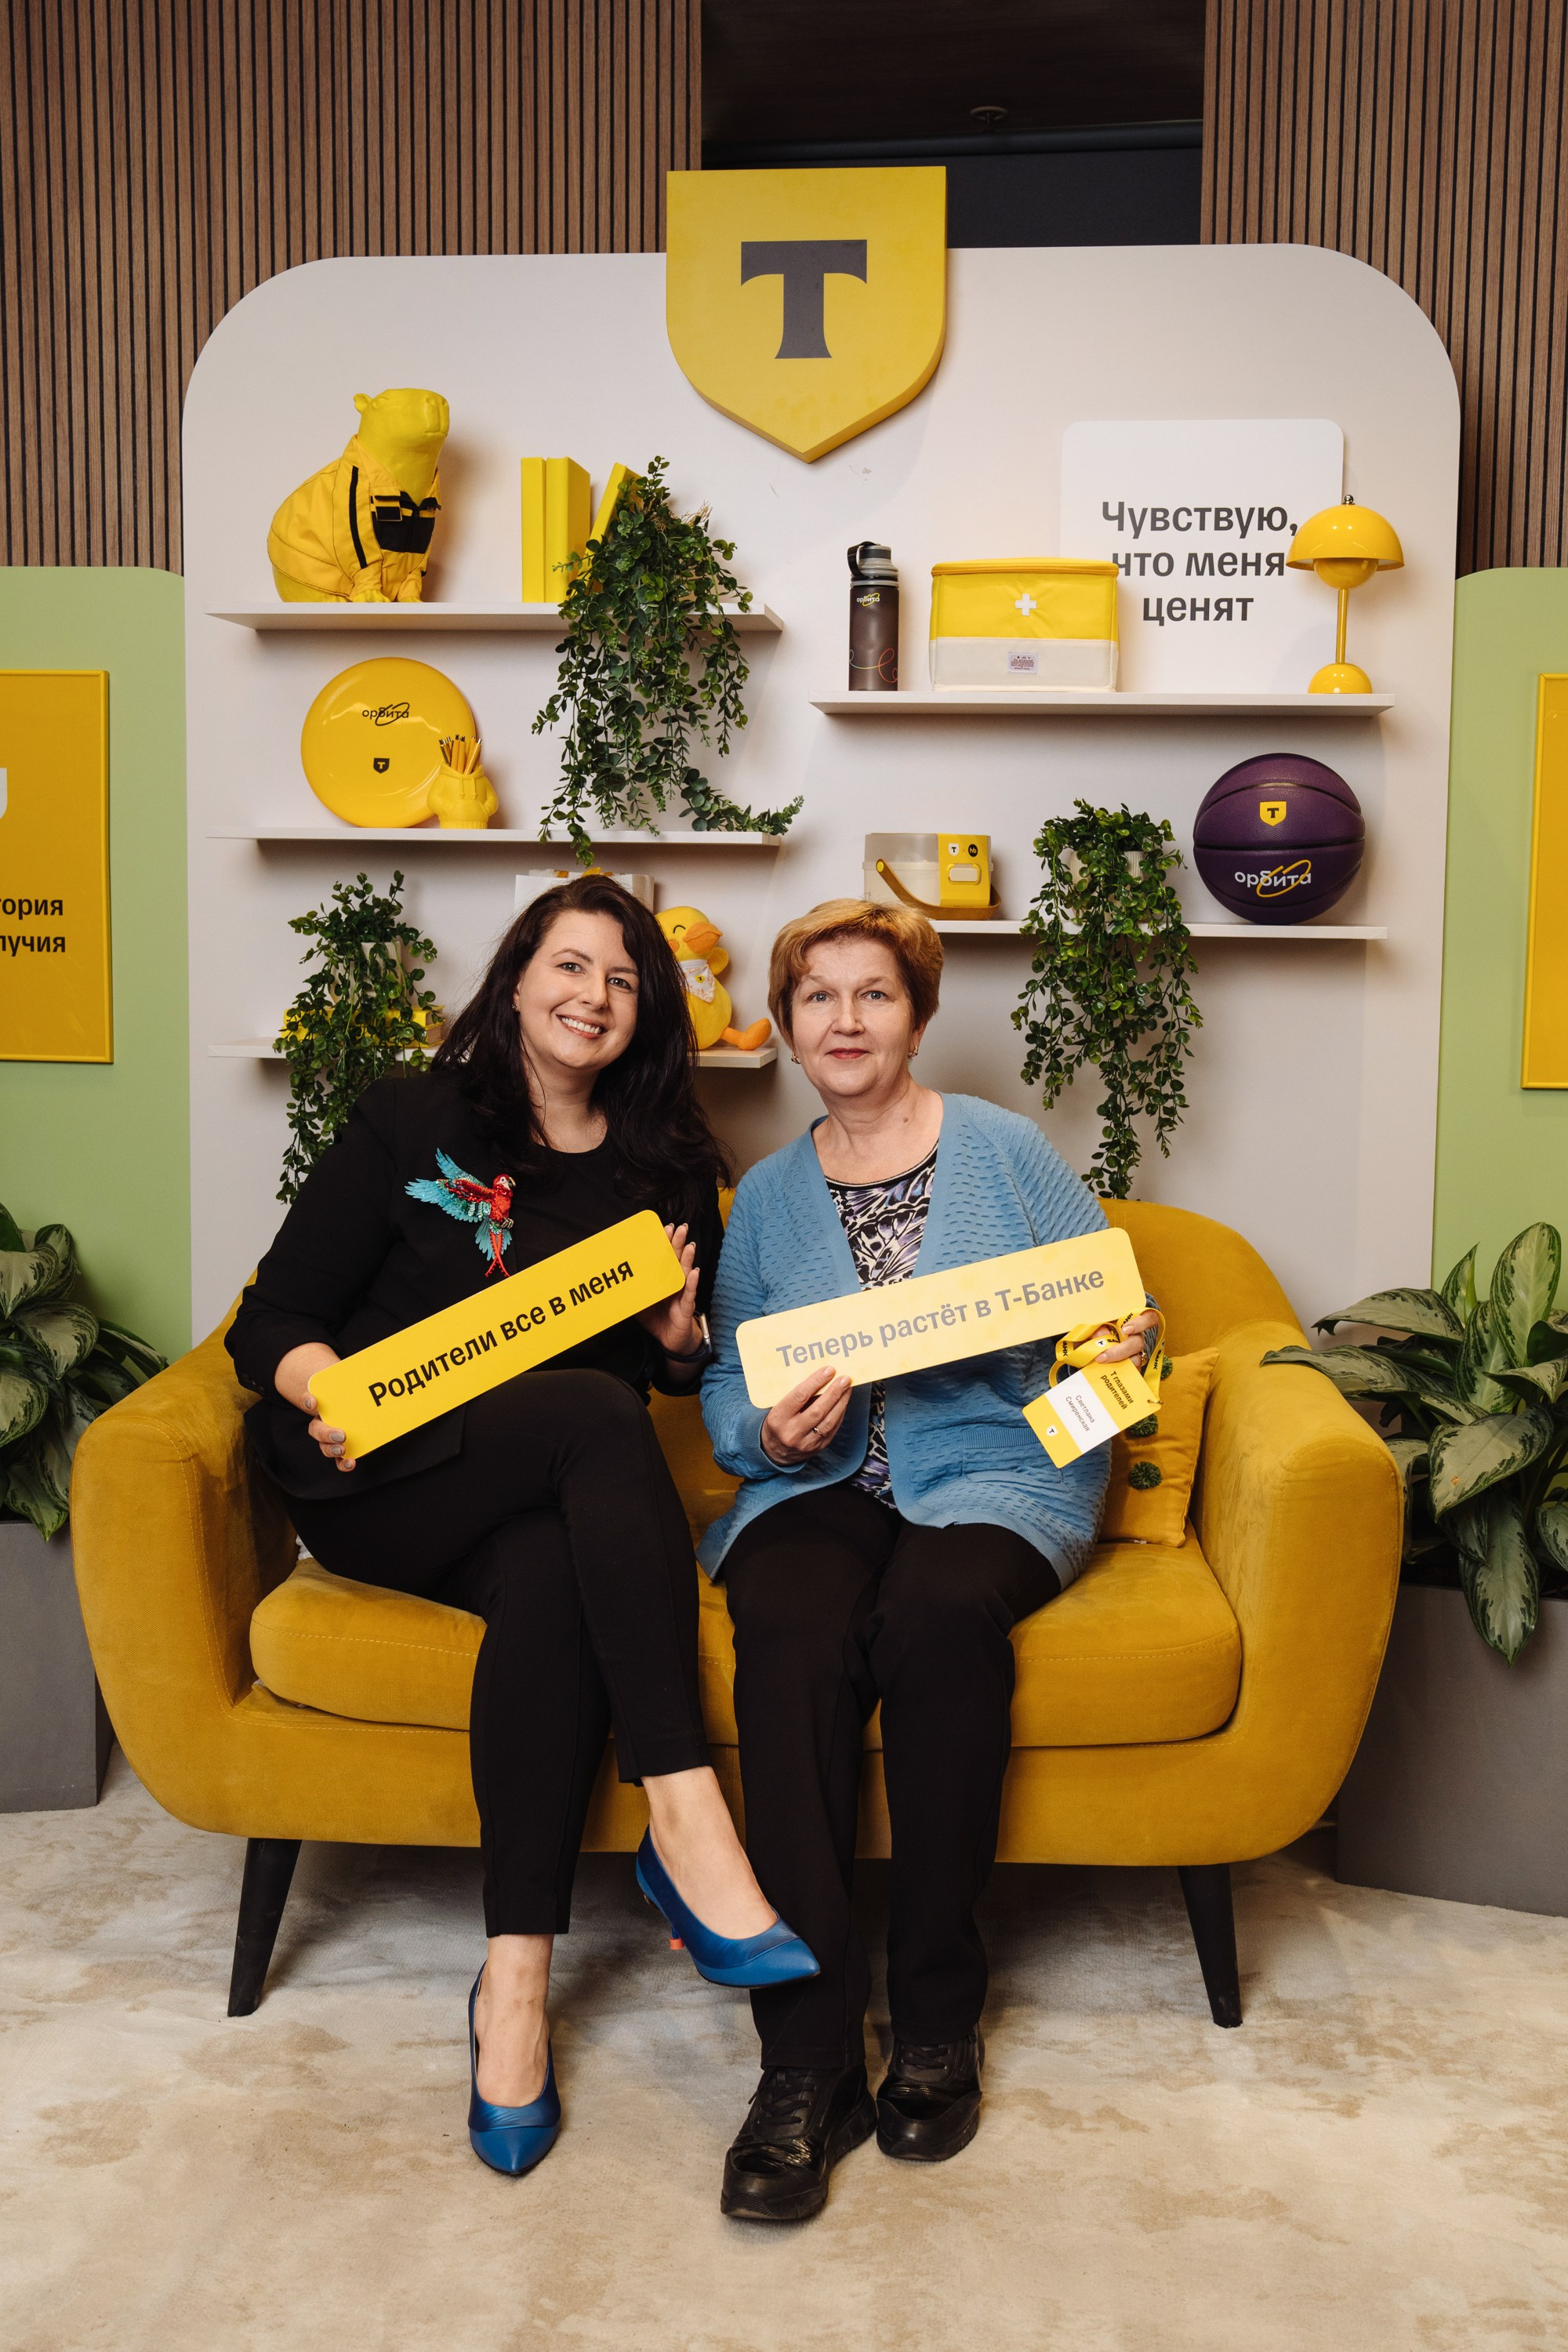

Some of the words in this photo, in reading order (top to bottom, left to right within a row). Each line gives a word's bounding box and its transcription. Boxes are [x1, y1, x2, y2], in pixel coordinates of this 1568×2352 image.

[741, 239, 867, 359] Т
[1102, 501, 1298, 539] Чувствую,
[1112, 552, 1174, 577] что
[1185, 551, 1285, 577] меня
[856, 595, 880, 604] орбита
[1143, 597, 1254, 626] ценят
[362, 706, 409, 720] орбита
[1267, 808, 1279, 818] Т
[1234, 869, 1312, 888] орбита
[0, 898, 64, 920] ория
[776, 1330, 873, 1367] Теперь
[878, 1303, 967, 1348] растёт
[976, 1299, 992, 1318] в
[994, 1270, 1105, 1312] Т-Банке
[368, 1330, 498, 1407] Родители
[499, 1306, 546, 1341] все
[548, 1296, 566, 1316] в
[569, 1261, 634, 1307] меня
[1100, 1374, 1128, 1410] родителей
[1113, 1374, 1134, 1404] глазами
[1065, 1396, 1090, 1432] Смиренская
[1075, 1395, 1095, 1424] Светлана
